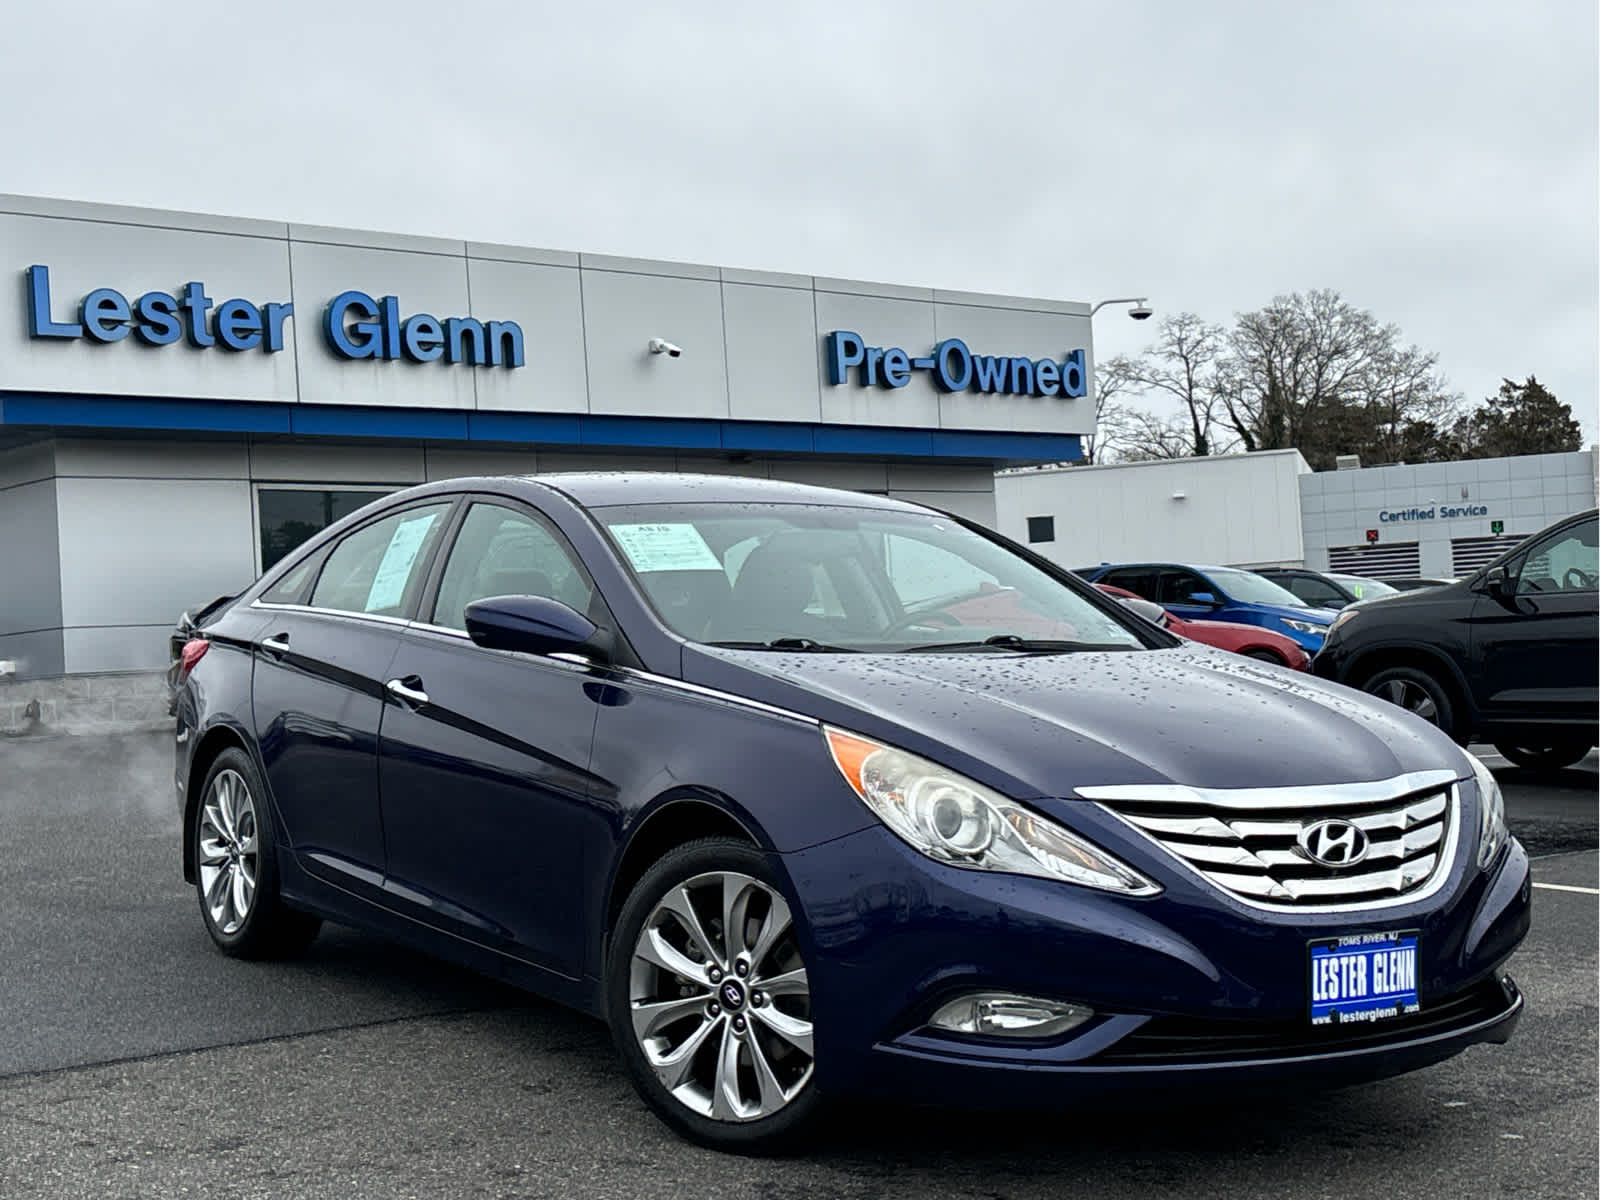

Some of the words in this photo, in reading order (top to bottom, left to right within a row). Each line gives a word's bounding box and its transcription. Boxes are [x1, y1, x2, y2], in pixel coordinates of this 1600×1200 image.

[25, 265, 293, 354] Lester
[324, 290, 525, 368] Glenn
[826, 331, 1087, 398] Pre-Owned
[1380, 507, 1435, 522] Certified
[1440, 504, 1488, 518] Service
[1338, 935, 1361, 947] TOMS
[1312, 955, 1367, 1001] LESTER
[1373, 949, 1415, 994] GLENN
[1339, 1007, 1398, 1024] lesterglenn
